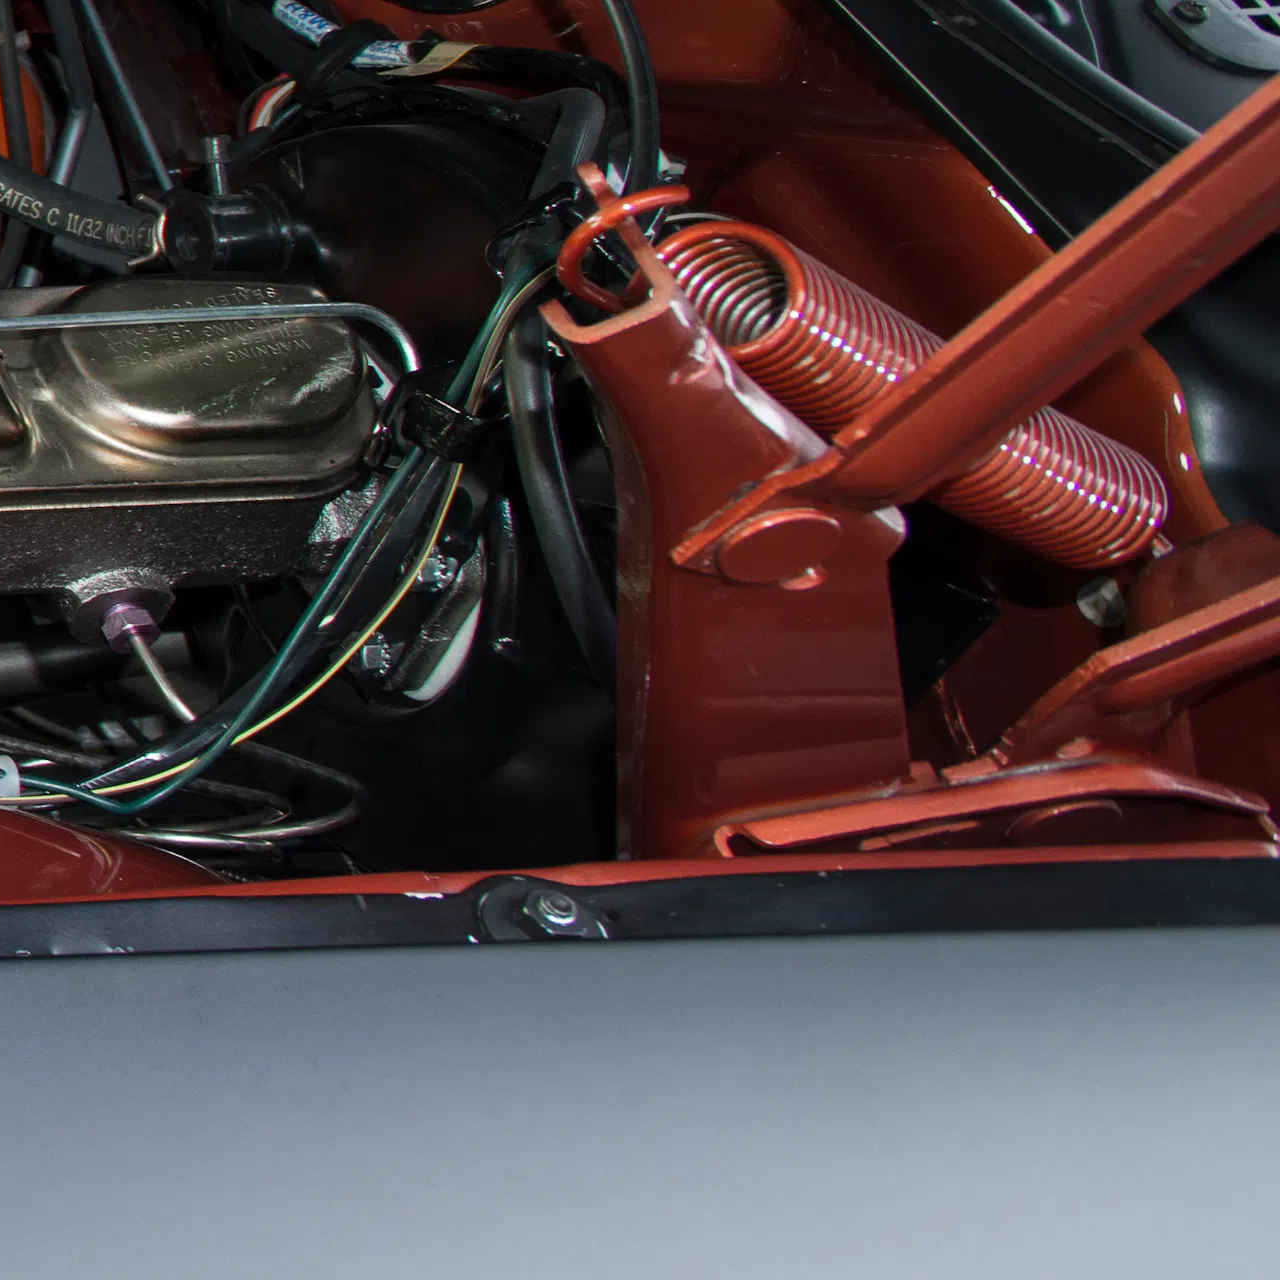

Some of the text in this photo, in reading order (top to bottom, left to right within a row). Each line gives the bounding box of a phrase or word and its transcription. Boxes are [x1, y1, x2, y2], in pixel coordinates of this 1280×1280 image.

[46, 207, 61, 227] C
[65, 212, 103, 240] 11/32
[105, 223, 136, 247] INCH
[104, 336, 152, 354] ONLY
[156, 328, 195, 344] USE
[235, 324, 304, 346] FILLER
[224, 338, 312, 364] WARNING
